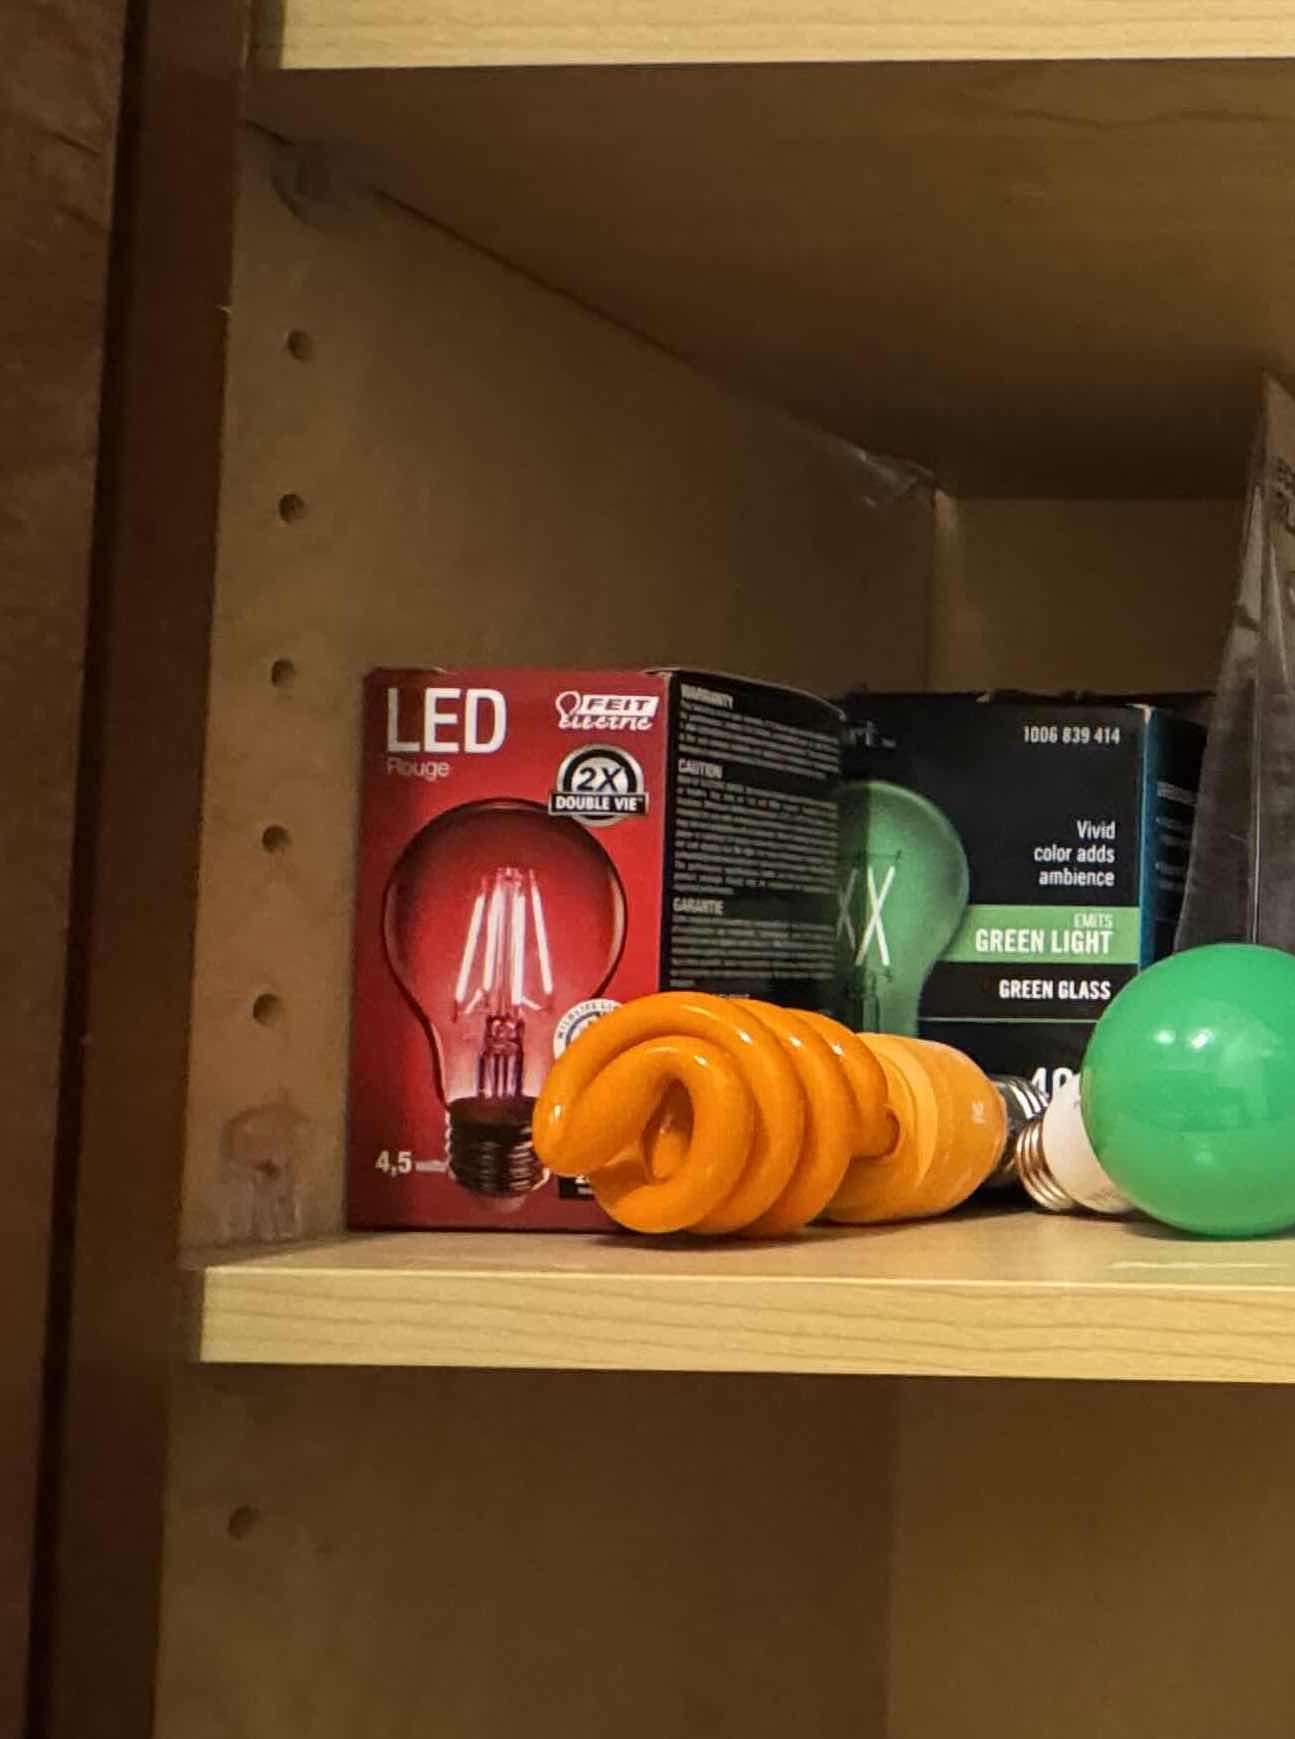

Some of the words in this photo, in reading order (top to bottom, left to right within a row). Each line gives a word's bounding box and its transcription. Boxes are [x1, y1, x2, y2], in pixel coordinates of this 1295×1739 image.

[584, 696, 650, 715] FEIT
[387, 686, 508, 754] LED
[1022, 725, 1058, 744] 1006
[1061, 727, 1091, 744] 839
[1093, 728, 1121, 745] 414
[386, 756, 452, 781] Rouge
[576, 765, 621, 793] 2X
[555, 796, 612, 812] DOUBLE
[1076, 820, 1116, 840] Vivid
[1033, 845, 1072, 863] color
[1076, 845, 1116, 864] adds
[1038, 868, 1116, 887] ambience
[974, 928, 1045, 953] GREEN
[1051, 930, 1114, 955] LIGHT
[998, 979, 1054, 999] GREEN
[1057, 980, 1112, 1000] GLASS
[375, 1151, 412, 1177] 4,5
